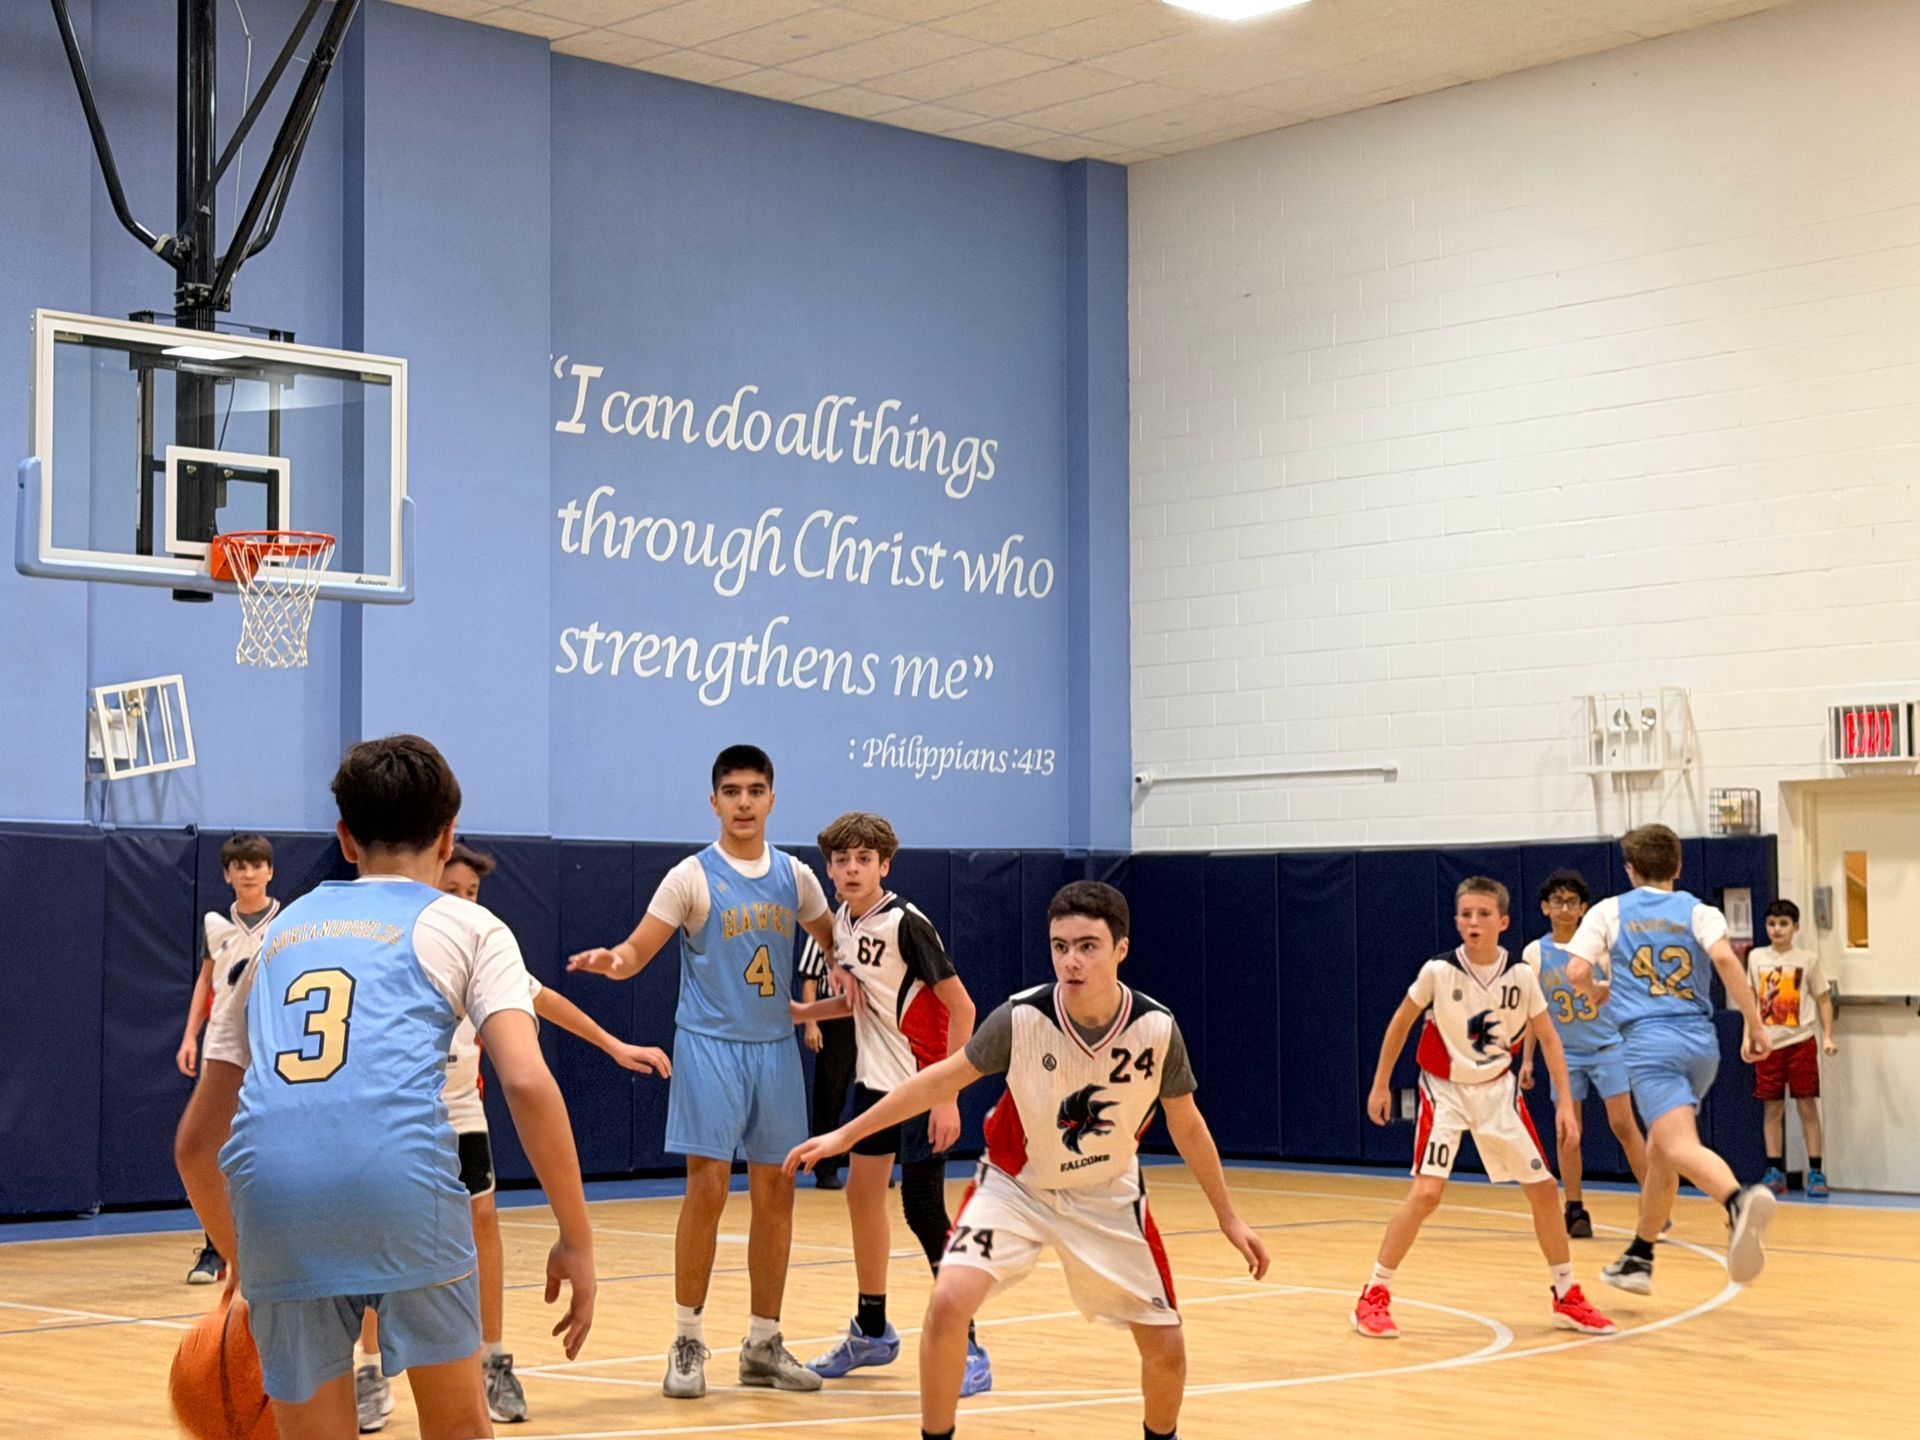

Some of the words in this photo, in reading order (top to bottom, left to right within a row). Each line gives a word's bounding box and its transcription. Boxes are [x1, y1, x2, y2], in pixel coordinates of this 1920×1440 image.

[601, 390, 700, 444] can
[774, 394, 857, 464] all
[849, 399, 999, 500] things
[557, 485, 787, 597] through
[793, 509, 947, 590] Christ
[952, 534, 1056, 599] who
[554, 615, 880, 707] strengthens
[1846, 710, 1894, 755] EXIT
[743, 944, 776, 997] 4
[857, 936, 886, 967] 67
[1629, 944, 1695, 1001] 42
[1500, 985, 1521, 1010] 10
[1553, 988, 1599, 1024] 33
[274, 967, 357, 1085] 3
[1109, 1047, 1155, 1083] 24
[1427, 1141, 1450, 1168] 10
[949, 1226, 994, 1260] 24
